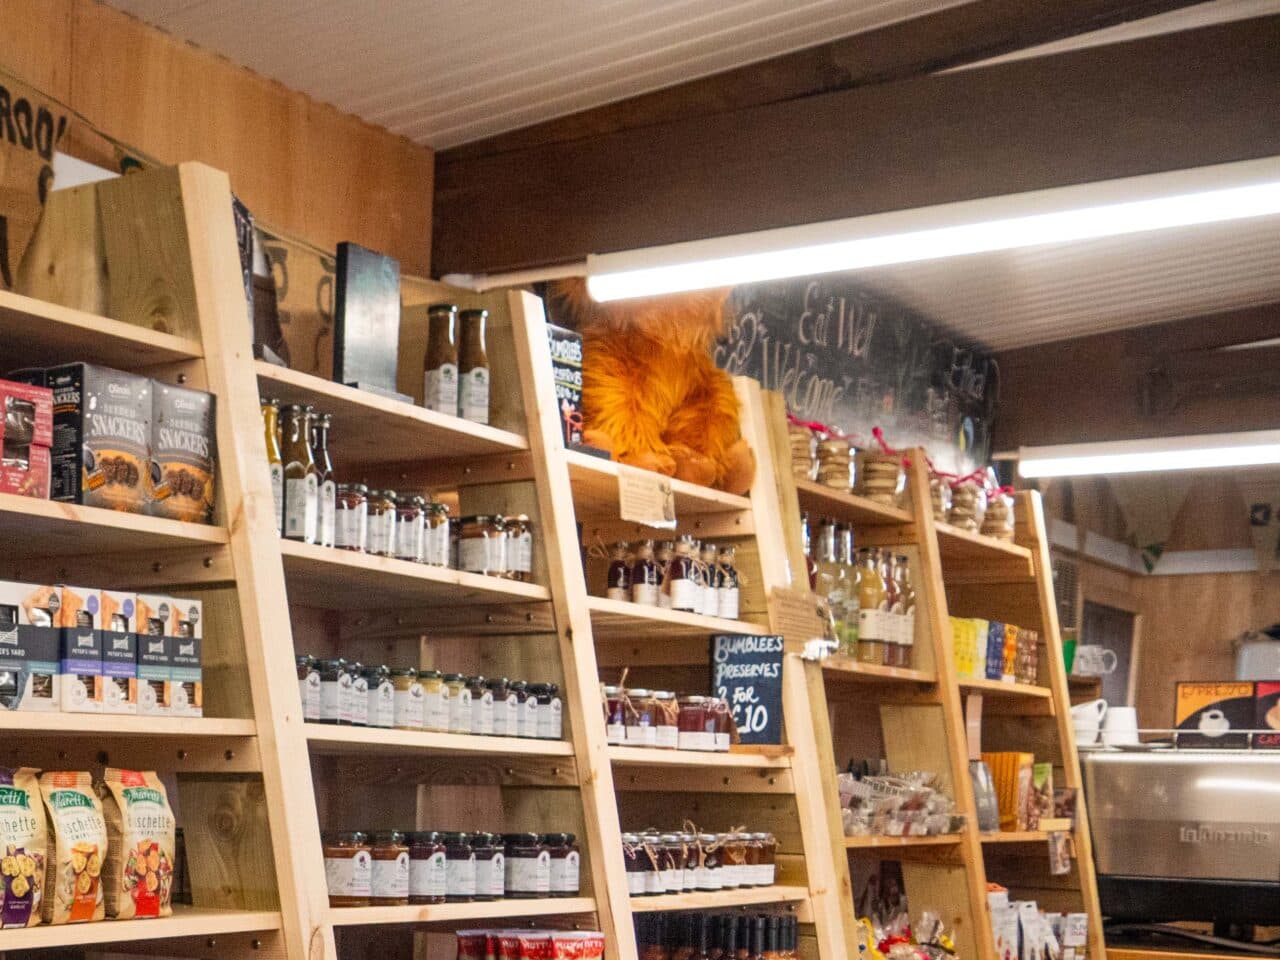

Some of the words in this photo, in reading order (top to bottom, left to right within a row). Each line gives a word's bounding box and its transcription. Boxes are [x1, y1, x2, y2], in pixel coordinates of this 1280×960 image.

[91, 414, 145, 445] SNACKERS
[159, 431, 209, 457] SNACKERS
[716, 662, 781, 687] PRESERVES
[733, 688, 758, 704] FOR
